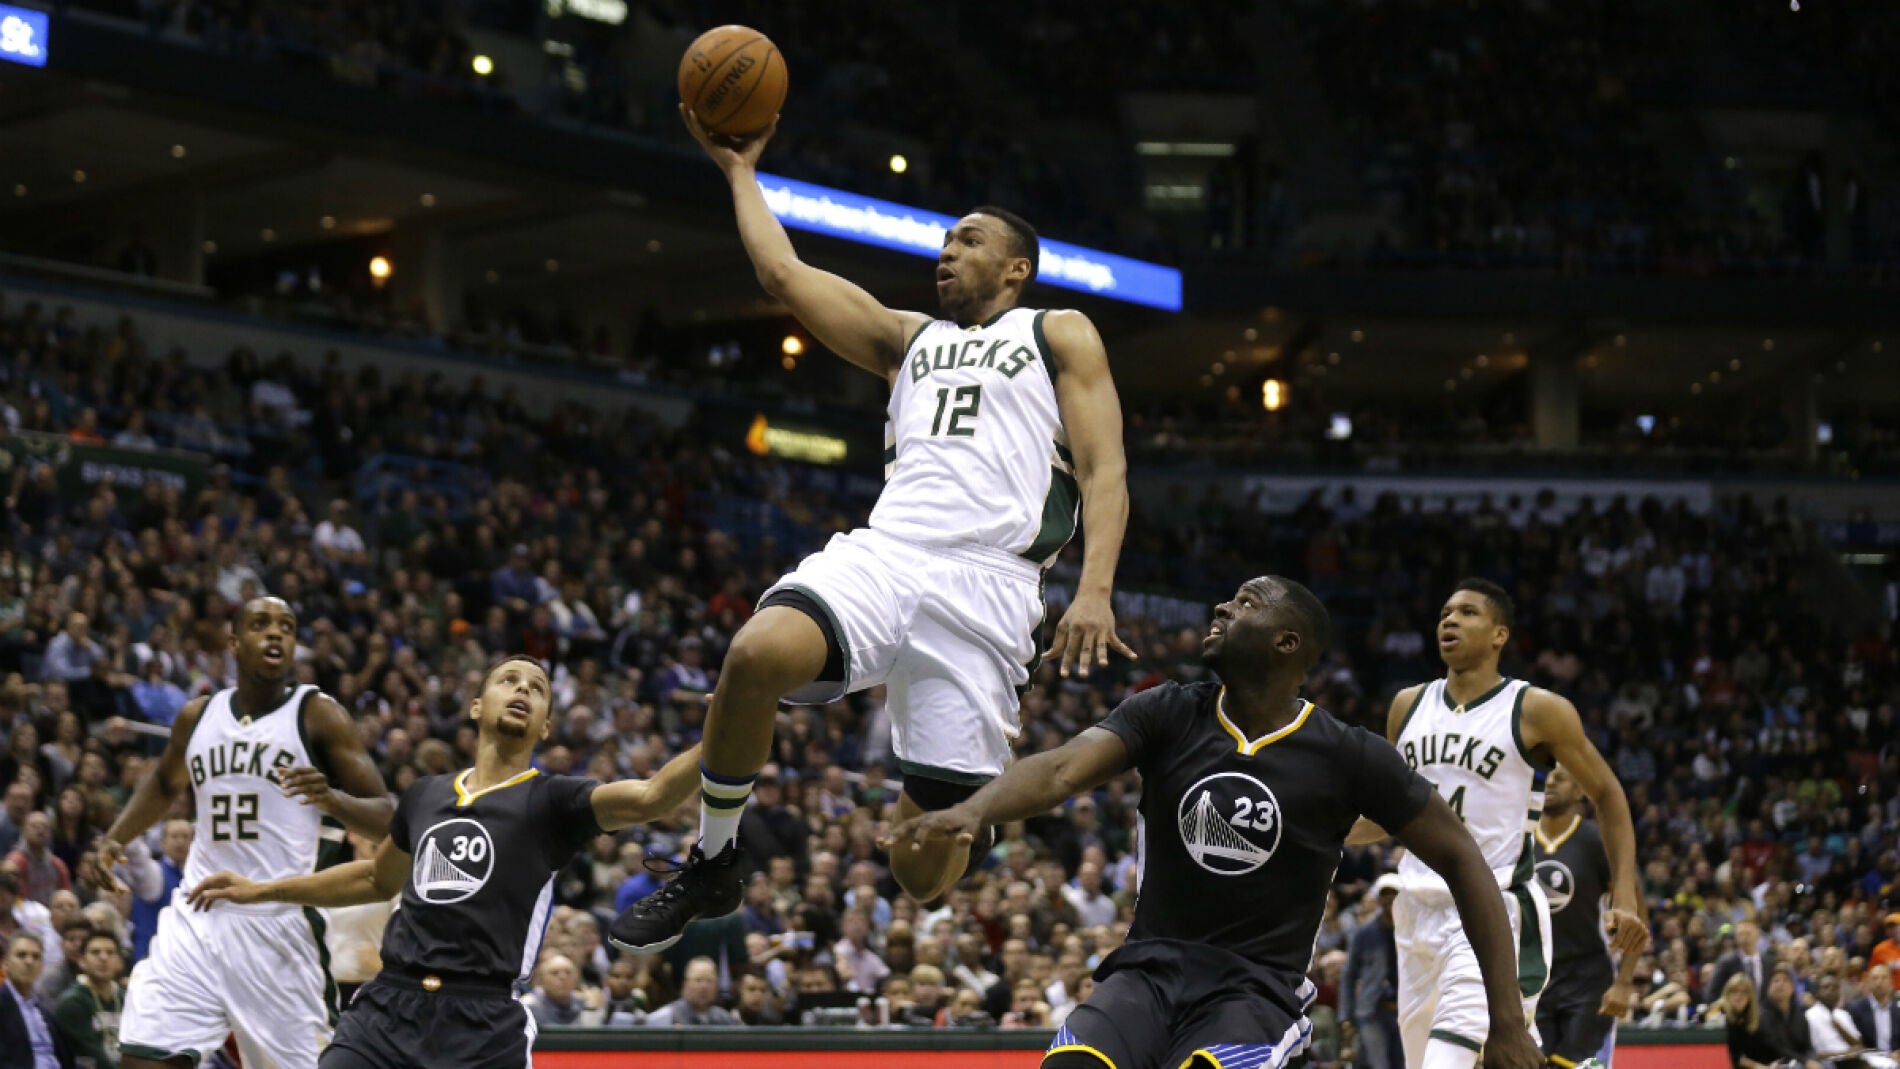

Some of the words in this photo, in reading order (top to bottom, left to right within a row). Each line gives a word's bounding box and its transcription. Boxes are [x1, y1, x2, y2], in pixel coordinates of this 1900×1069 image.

[911, 339, 1036, 384] BUCKS
[930, 384, 982, 438] 12
[191, 740, 296, 786] BUCKS
[1404, 733, 1505, 780] BUCKS
[211, 793, 260, 843] 22
[1229, 796, 1274, 833] 23
[449, 835, 487, 863] 30
